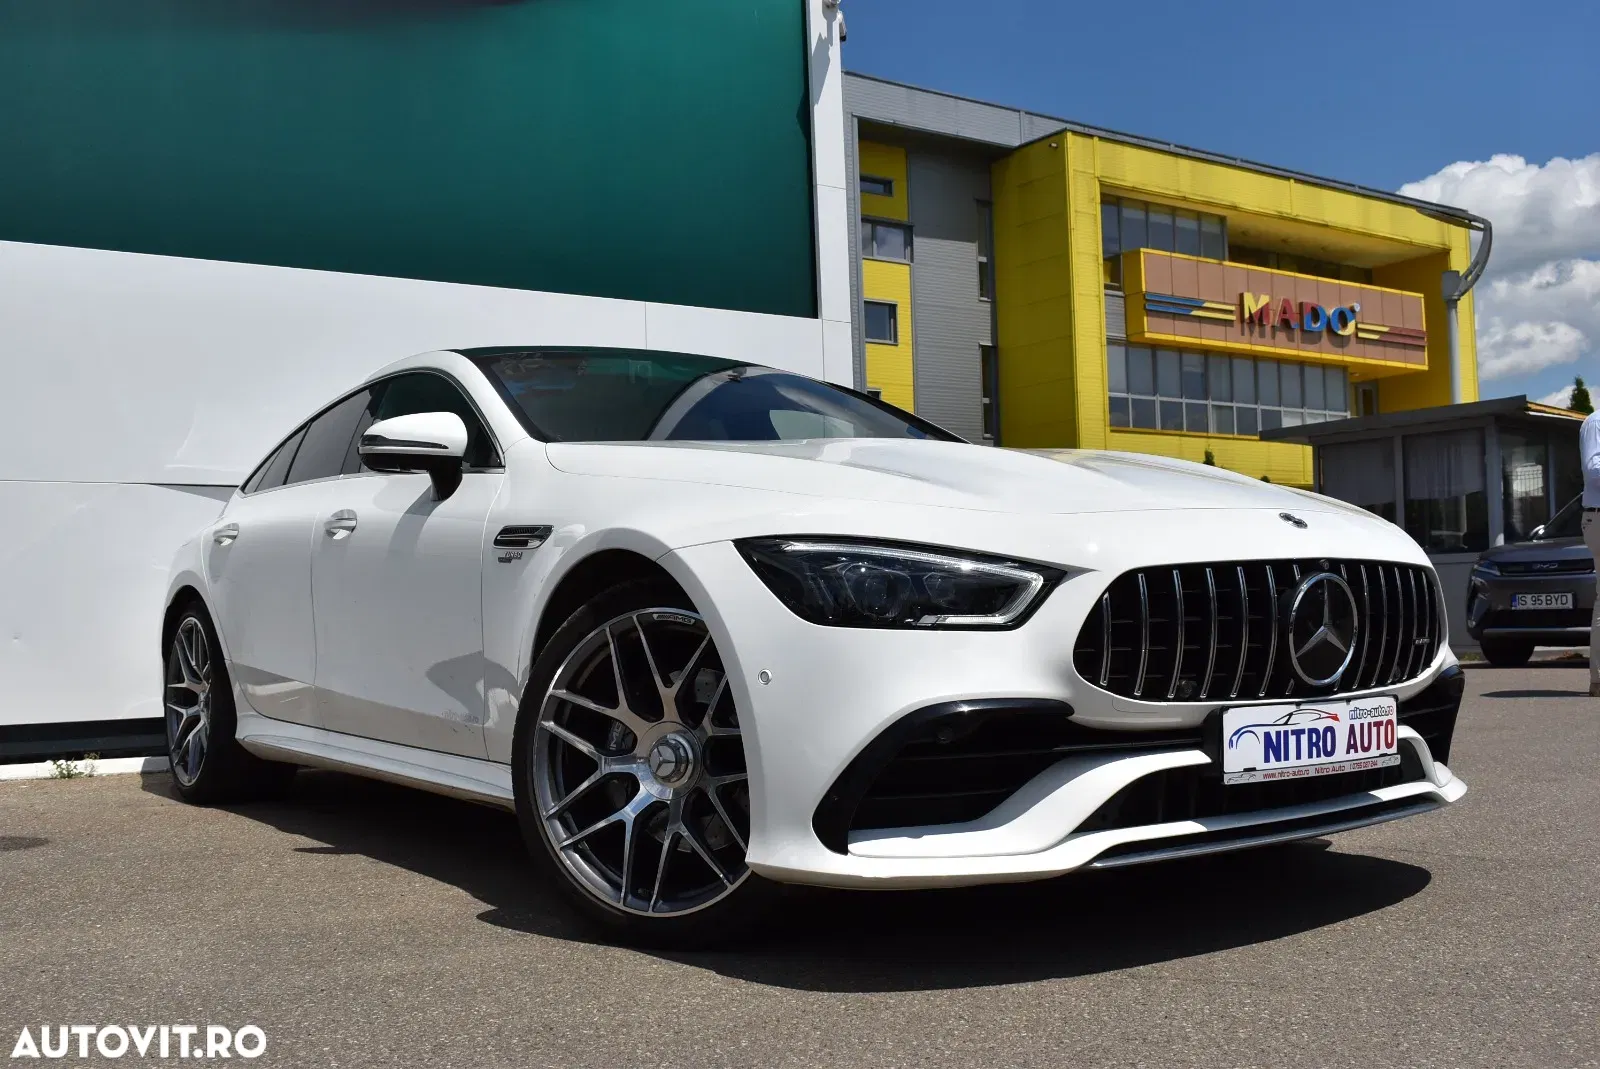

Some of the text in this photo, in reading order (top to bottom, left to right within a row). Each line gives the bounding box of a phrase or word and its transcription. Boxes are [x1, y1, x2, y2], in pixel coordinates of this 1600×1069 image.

[1239, 291, 1357, 336] MADO
[1517, 594, 1569, 606] IS 95 BYD
[1348, 705, 1394, 720] nitro-auto.ro
[1263, 718, 1395, 763] NITRO AUTO
[1314, 766, 1331, 775] Nitro
[1331, 764, 1346, 773] Auto
